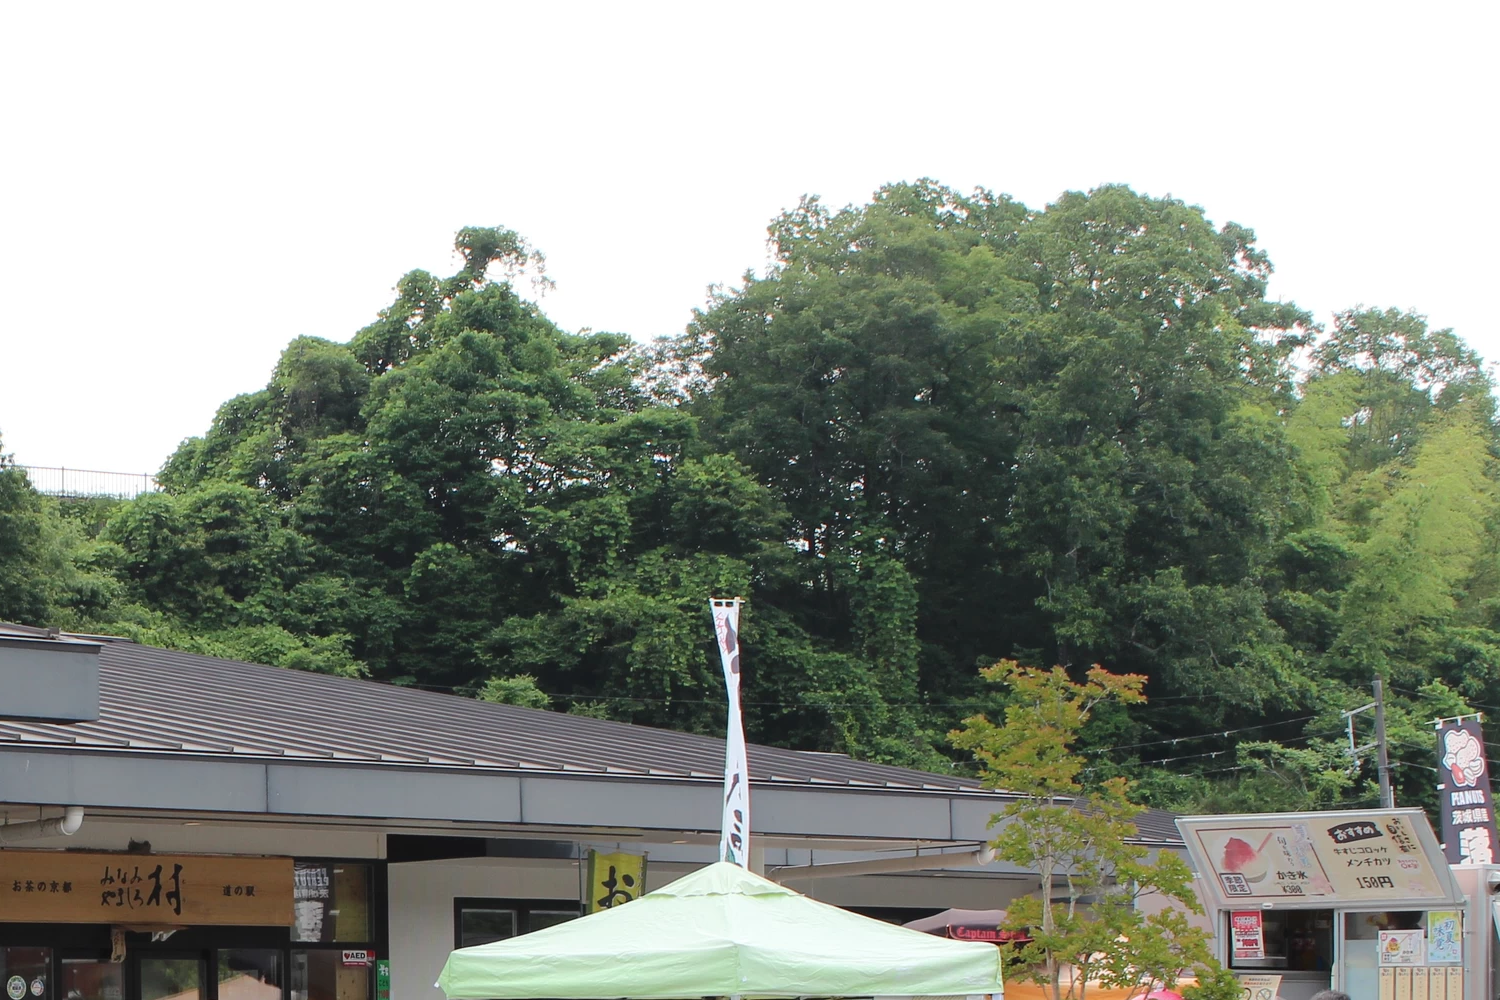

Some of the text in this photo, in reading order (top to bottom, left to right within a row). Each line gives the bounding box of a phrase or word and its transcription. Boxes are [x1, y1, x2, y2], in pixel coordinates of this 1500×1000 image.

[1451, 790, 1485, 806] PEANUTS
[1452, 808, 1489, 825] 茨城県産
[1334, 825, 1375, 841] おすすめ
[1333, 846, 1388, 855] 牛すじコロッケ
[1346, 857, 1391, 867] メンチカツ
[1276, 870, 1308, 880] かき氷
[12, 880, 73, 893] お茶の京都
[597, 865, 634, 909] お
[1356, 876, 1394, 889] 150円
[222, 885, 256, 897] 道の駅
[956, 926, 996, 939] Captain
